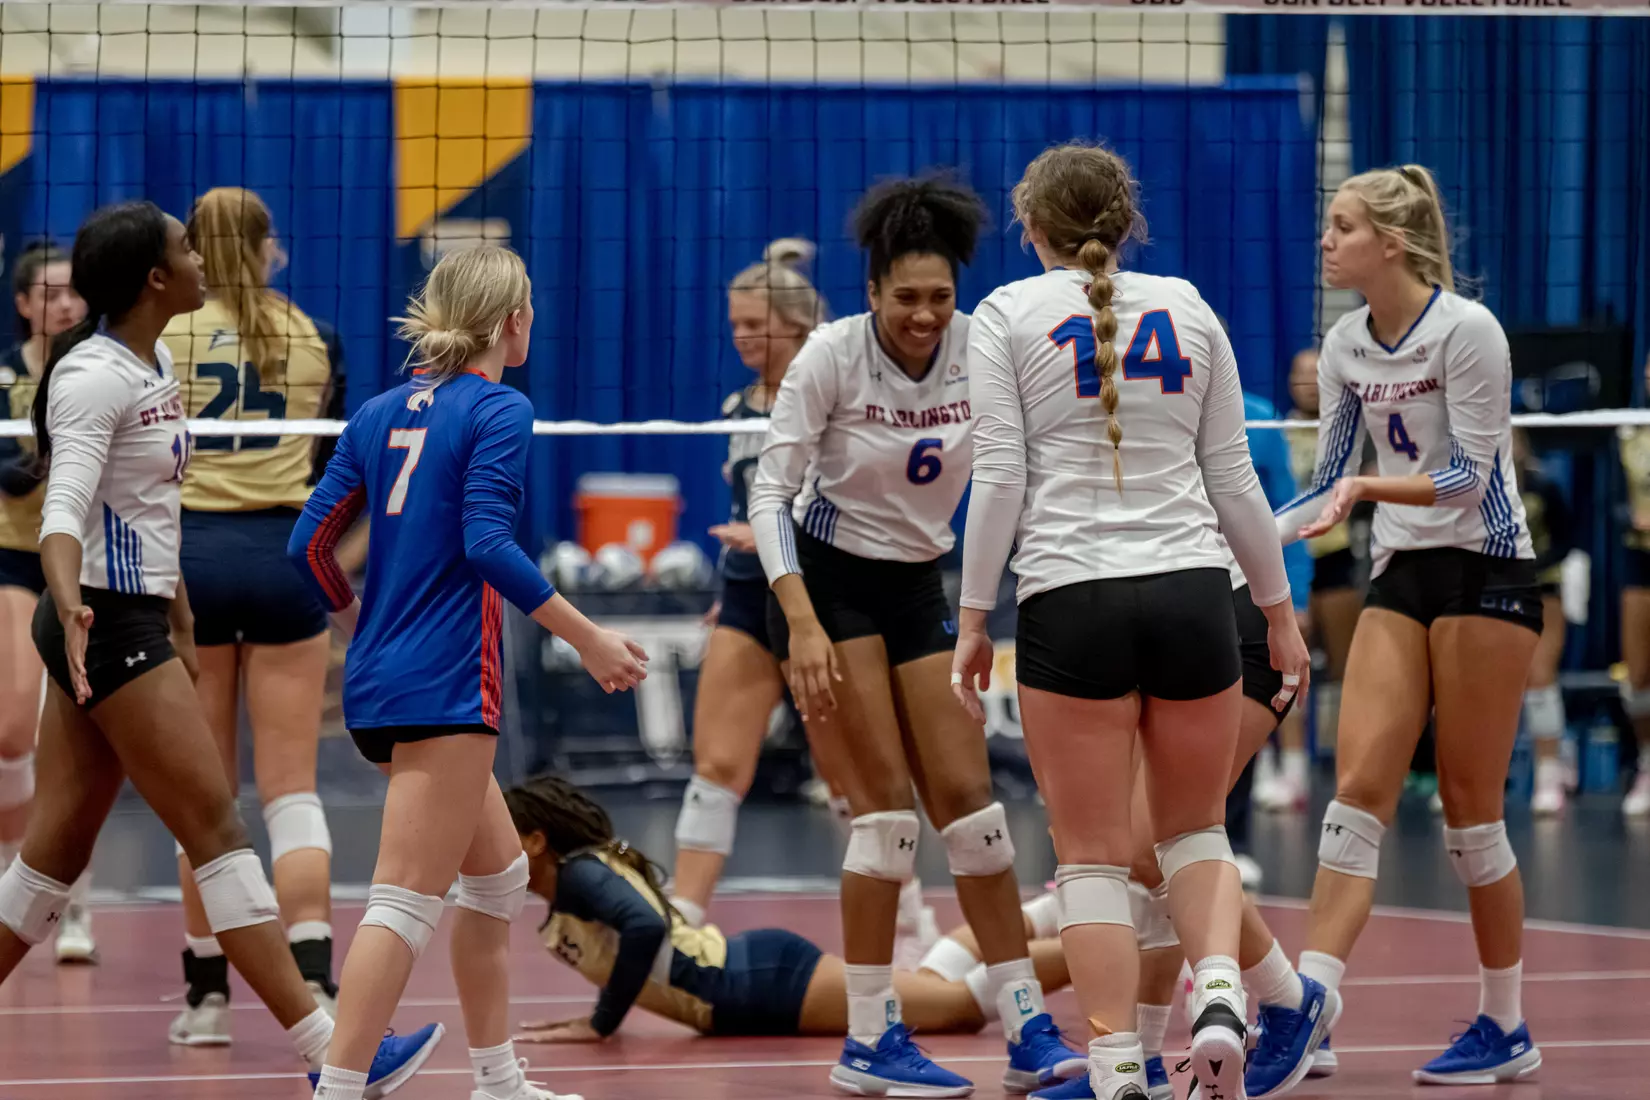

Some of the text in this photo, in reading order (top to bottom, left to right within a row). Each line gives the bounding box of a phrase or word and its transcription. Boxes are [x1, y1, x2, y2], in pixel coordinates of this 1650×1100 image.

[1047, 308, 1193, 398] 14
[195, 362, 287, 452] 25
[890, 400, 972, 430] ARLINGTO
[1387, 413, 1418, 461] 4
[385, 427, 429, 516] 7
[906, 438, 944, 486] 6
